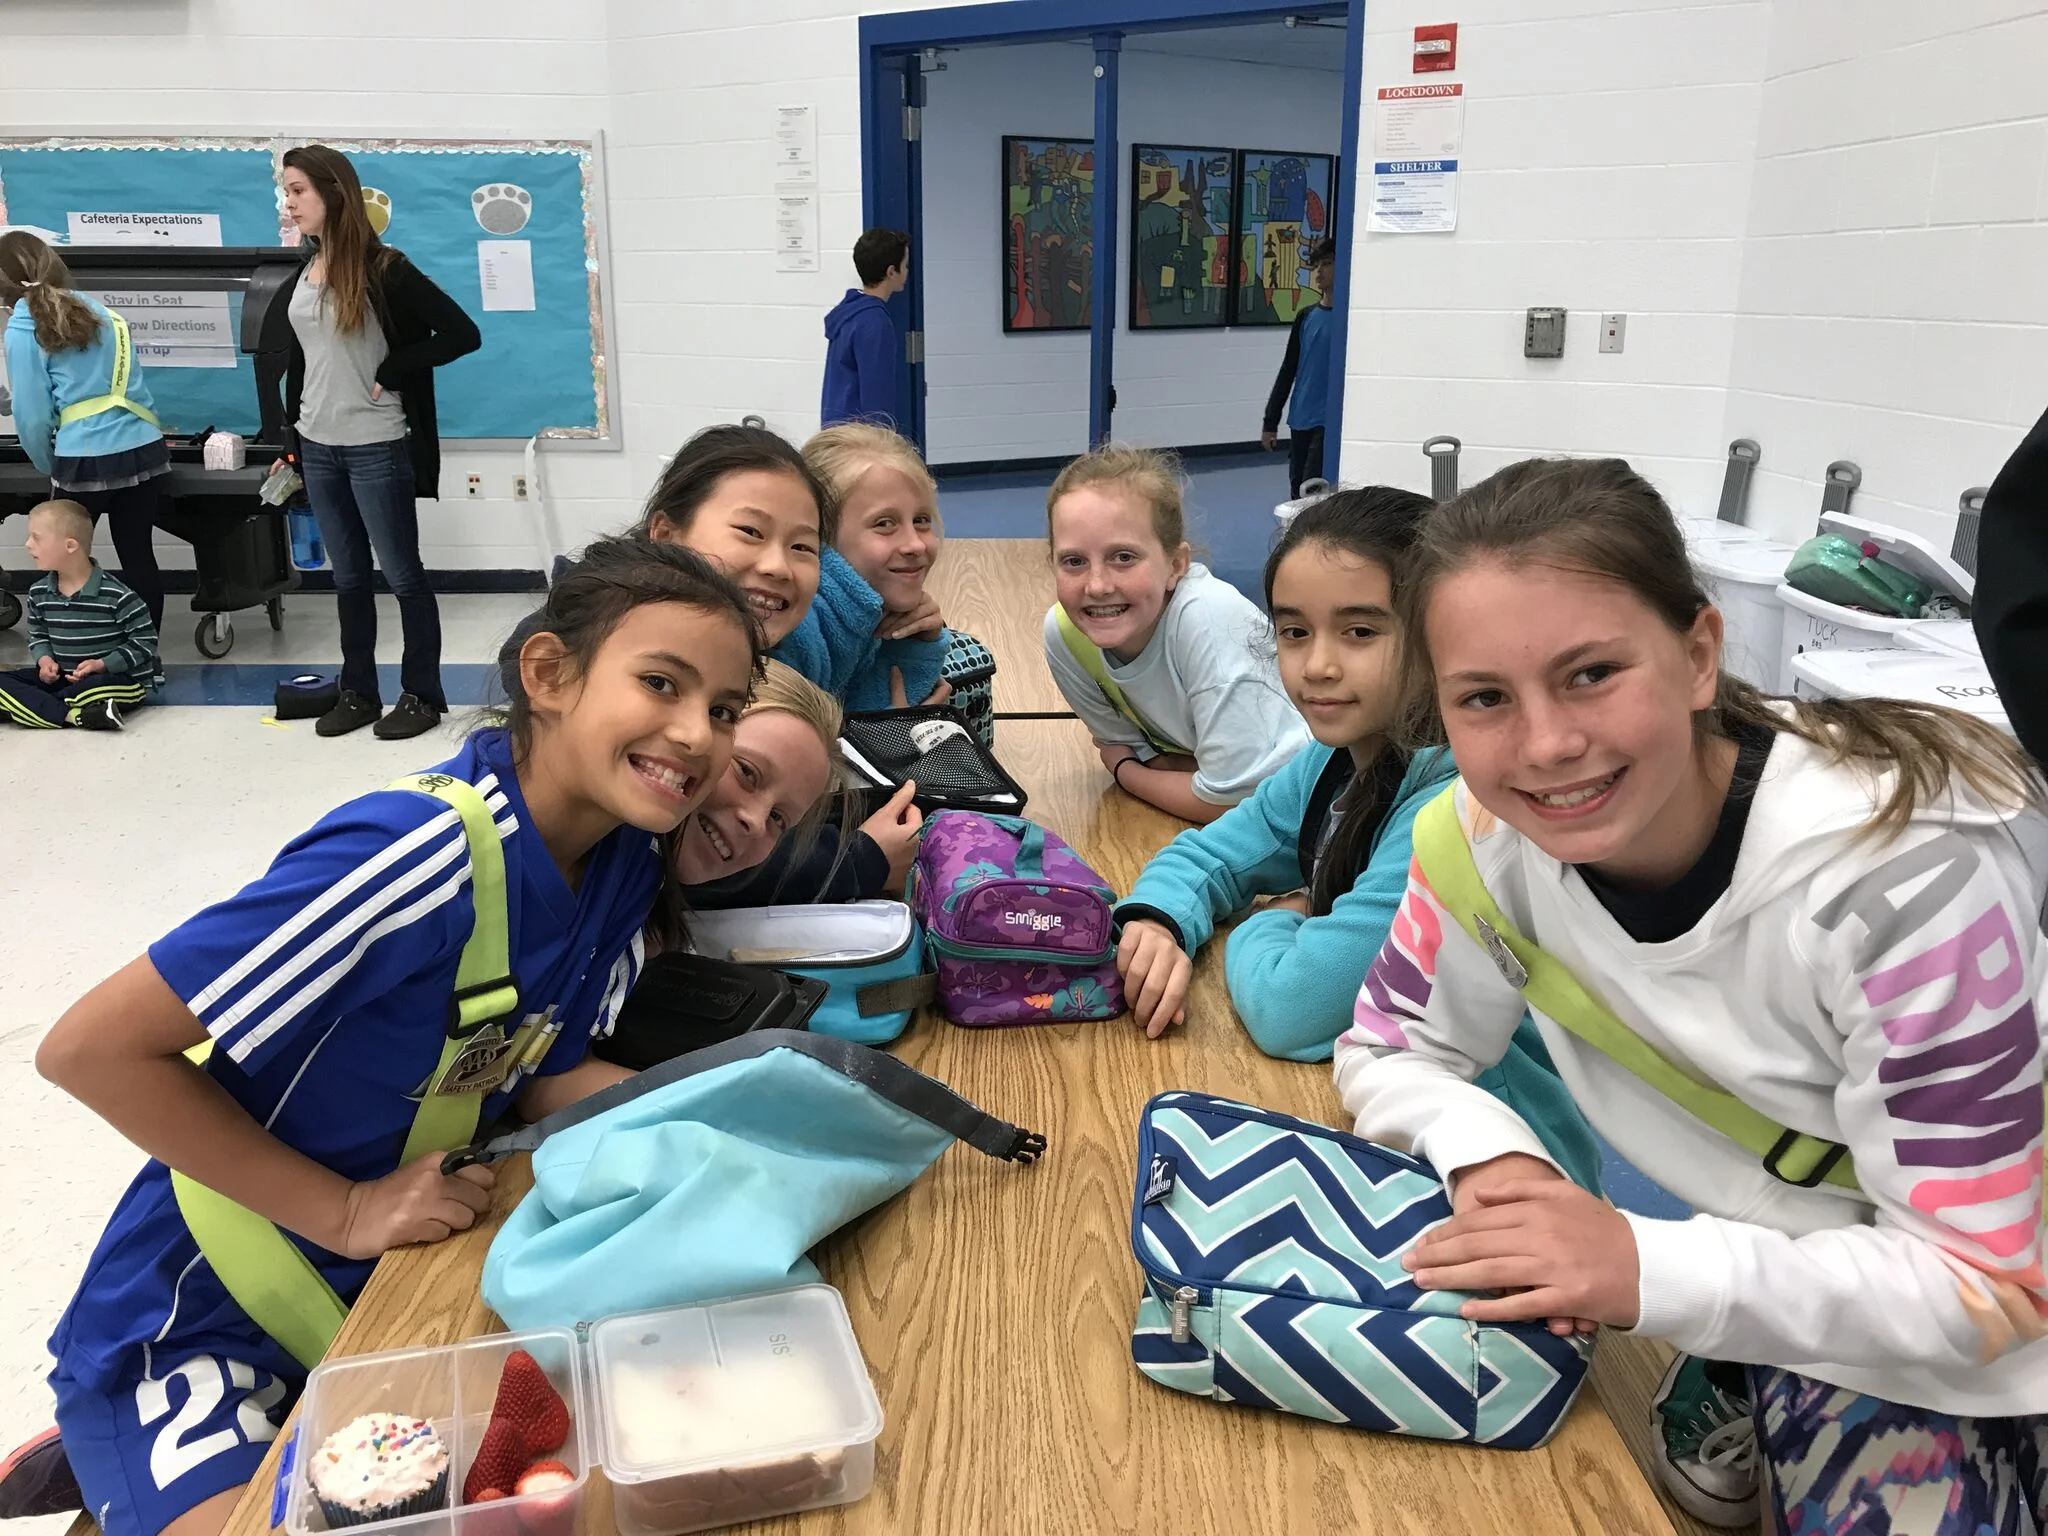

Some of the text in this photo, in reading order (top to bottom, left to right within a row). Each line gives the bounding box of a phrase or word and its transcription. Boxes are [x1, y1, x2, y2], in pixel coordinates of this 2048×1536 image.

[1385, 85, 1455, 98] LOCKDOWN
[1389, 161, 1442, 173] SHELTER
[80, 213, 203, 226] Cafeteria Expectations
[137, 294, 150, 305] in
[153, 294, 183, 305] Seat
[152, 319, 216, 332] Directions
[1807, 614, 1839, 645] TUCK
[1936, 685, 2001, 700] Roo
[1005, 908, 1062, 931] Smiggle
[444, 1075, 499, 1093] SAFETY PATROL
